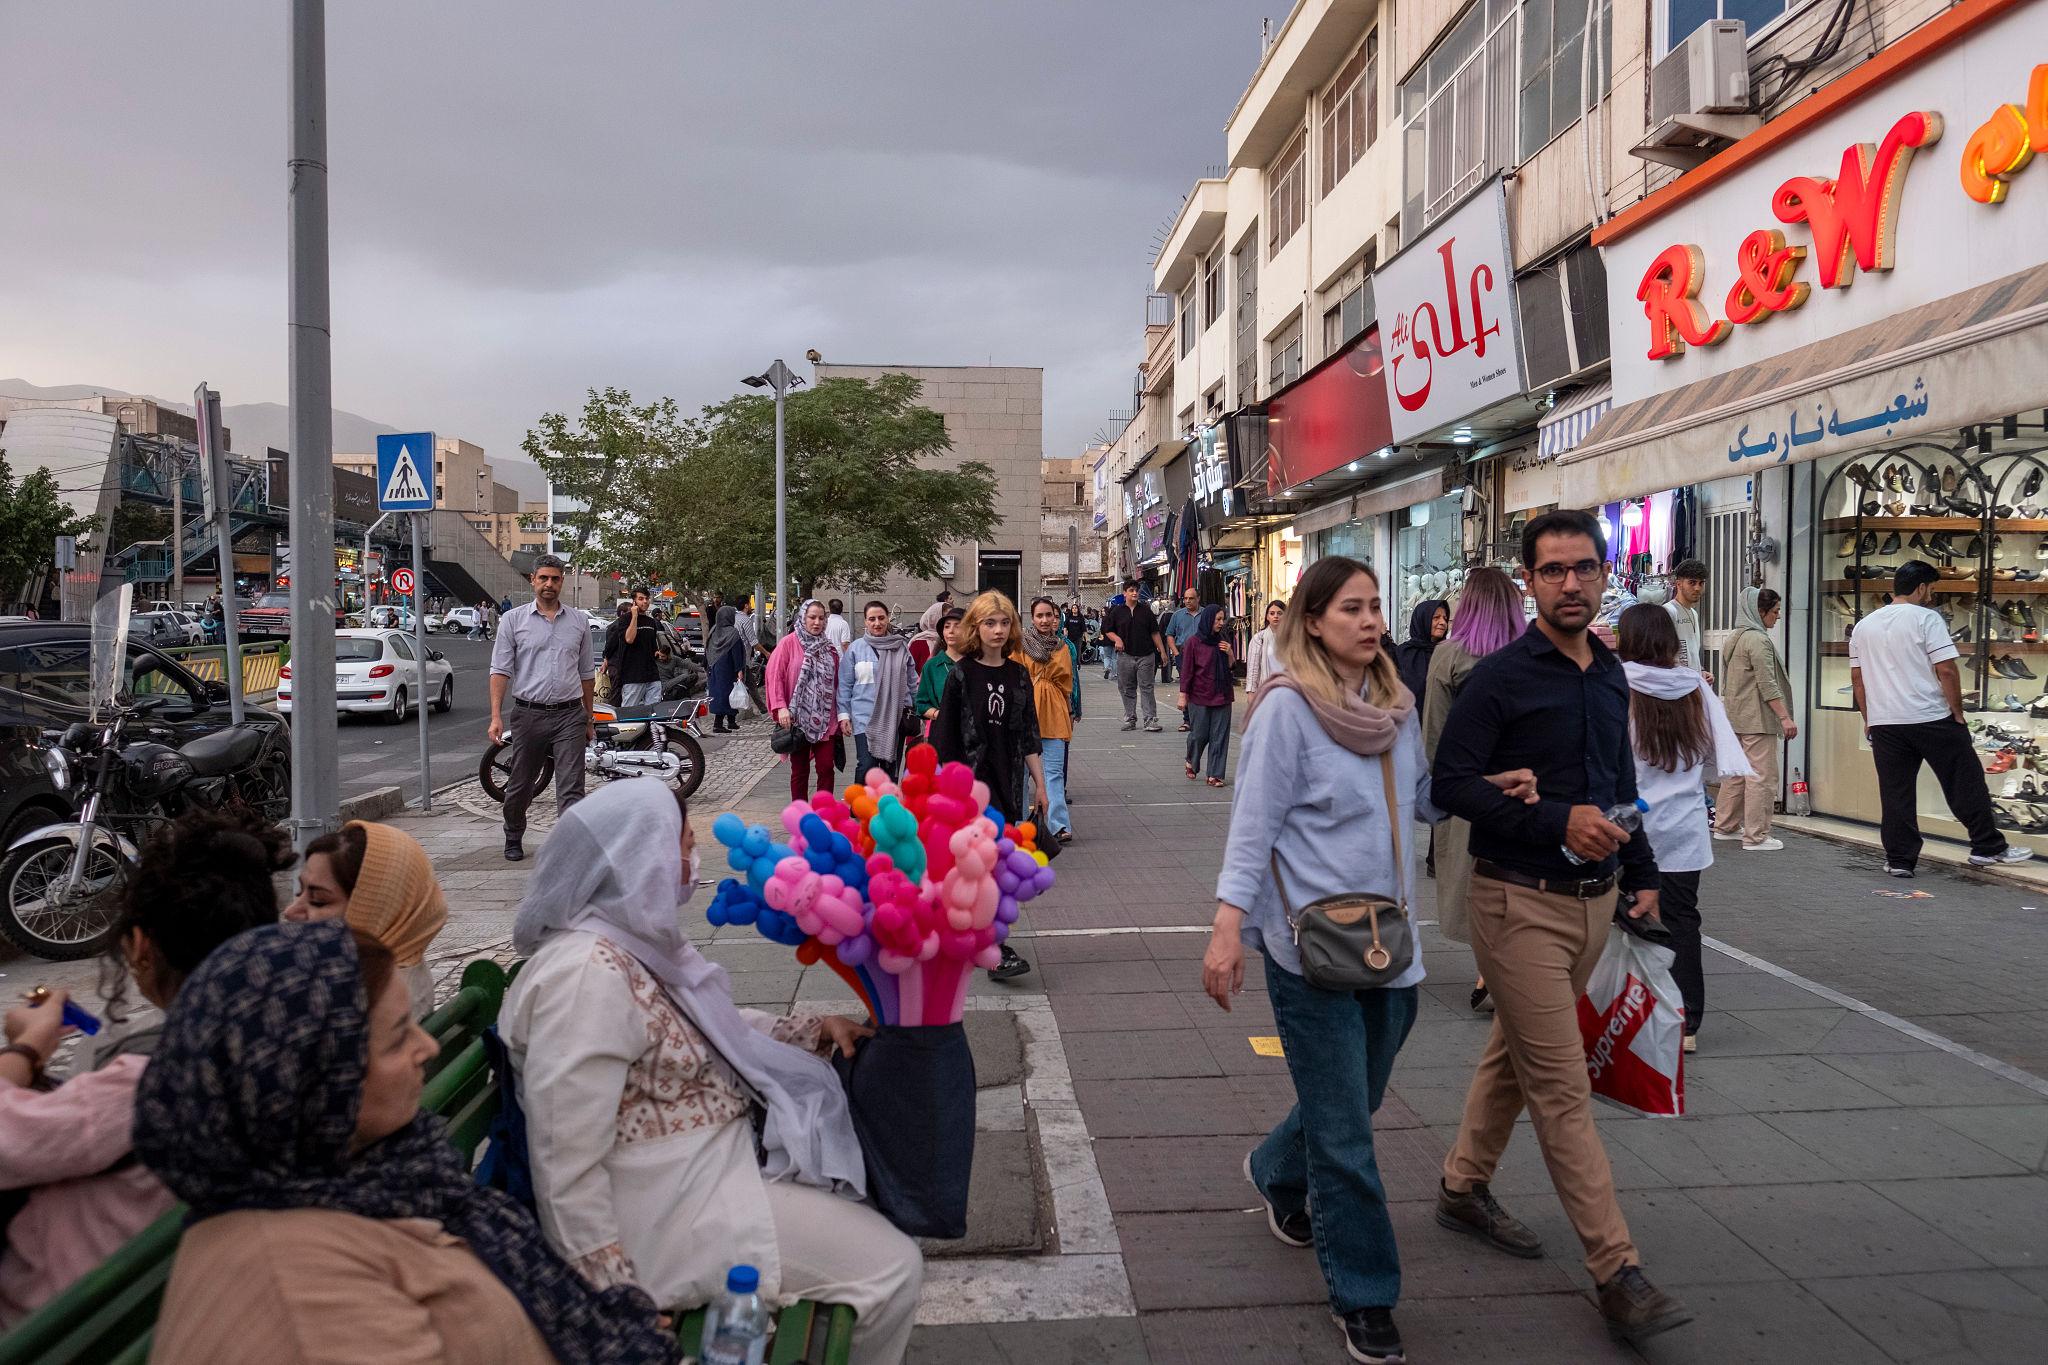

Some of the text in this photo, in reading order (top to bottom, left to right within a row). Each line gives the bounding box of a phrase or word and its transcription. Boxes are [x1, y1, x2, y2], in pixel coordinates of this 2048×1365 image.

[1391, 312, 1409, 352] Ali
[1470, 380, 1478, 388] Men
[1482, 373, 1496, 383] Women
[1495, 368, 1507, 377] Shoes
[1728, 376, 1928, 463] شعبه نارمک
